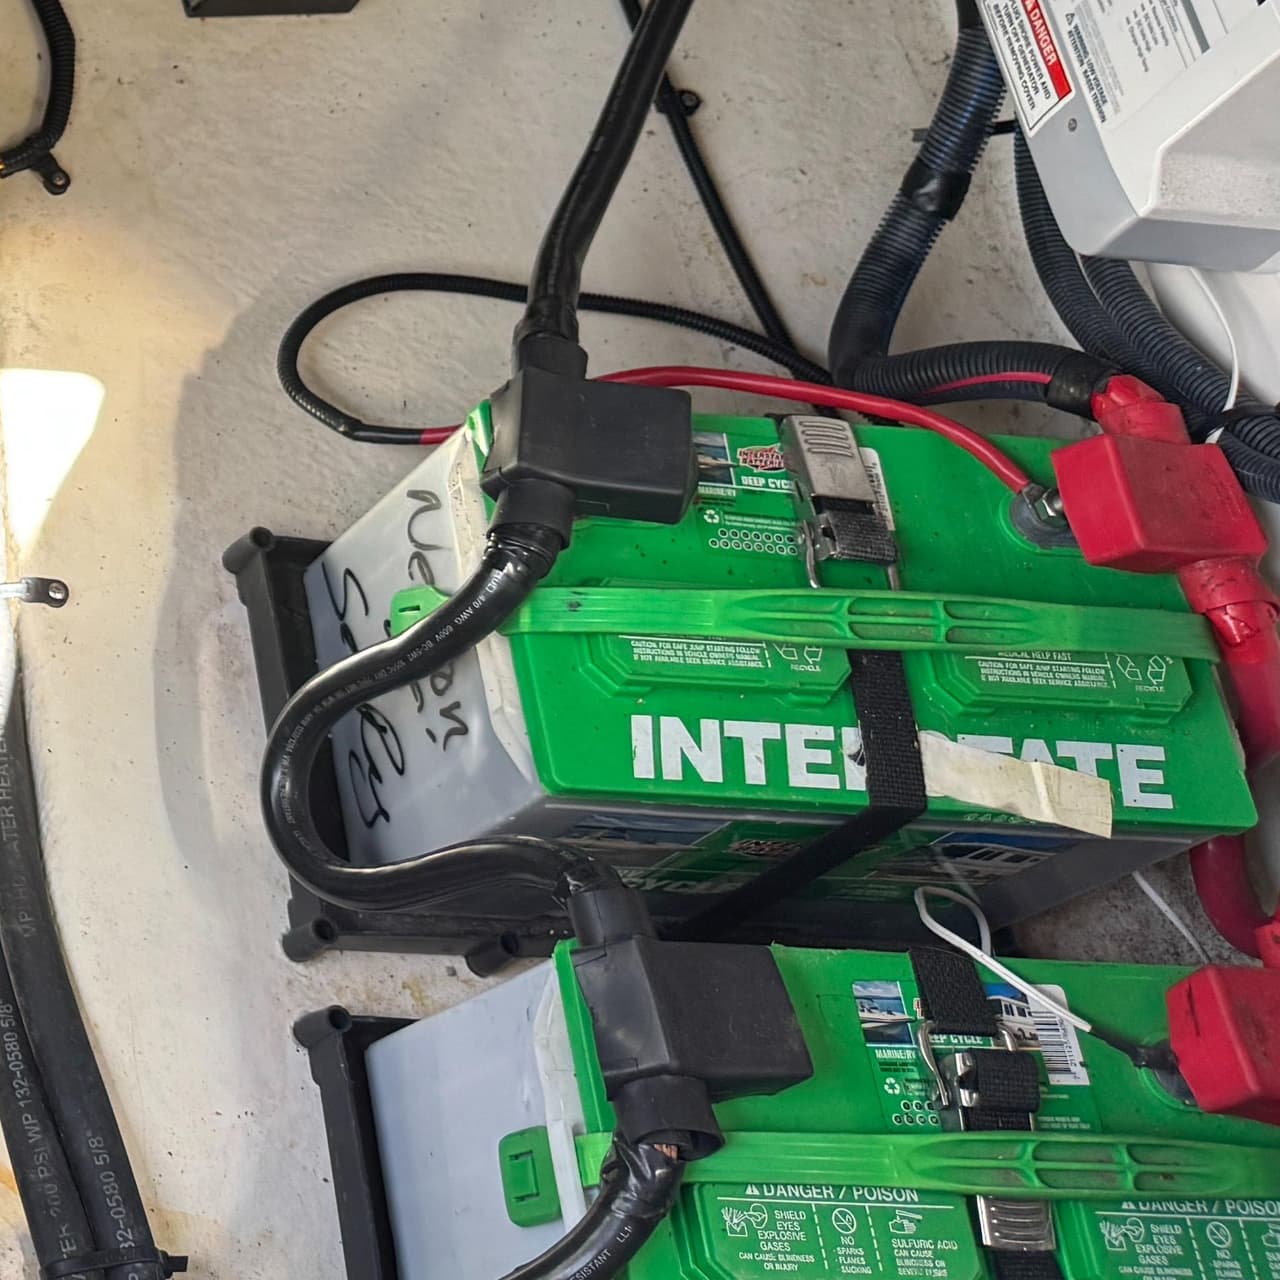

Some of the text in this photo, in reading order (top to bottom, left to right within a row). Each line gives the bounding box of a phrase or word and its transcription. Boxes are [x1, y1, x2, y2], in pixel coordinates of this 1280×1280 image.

[1014, 17, 1035, 49] SHORE
[1026, 7, 1059, 66] DANGER
[999, 2, 1045, 95] TURN OFF GENERATOR
[989, 2, 1039, 111] BEFORE REMOVING COVER
[1024, 47, 1047, 81] POWER
[1037, 78, 1053, 100] AND
[741, 475, 766, 487] DEEP
[450, 604, 476, 626] AWG
[431, 622, 455, 643] 600V
[735, 646, 761, 654] FOLLOW
[1052, 652, 1073, 662] FAST
[1081, 666, 1105, 675] FOLLOW
[951, 1034, 984, 1045] CYCLE
[875, 1049, 916, 1060] MARINE/RV
[1, 1029, 34, 1108] 132-0580
[20, 1110, 43, 1143] WP
[31, 1144, 54, 1179] PSI
[763, 1183, 835, 1200] DANGER
[852, 1187, 919, 1203] POISON
[98, 1167, 137, 1251] 32-0580
[773, 1209, 807, 1220] SHIELD
[776, 1220, 801, 1231] EYES
[1150, 1224, 1182, 1235] SHIELD
[757, 1230, 807, 1241] EXPLOSIVE
[840, 1236, 855, 1246] NO
[1153, 1235, 1177, 1245] EYES
[759, 1241, 791, 1252] GASES
[891, 1238, 959, 1250] SULFURIC ACID
[1135, 1244, 1184, 1255] EXPLOSIVE
[738, 1251, 815, 1263] CAN CAUSE BLINDNESS
[893, 1249, 934, 1259] CAN CAUSE
[1216, 1250, 1232, 1260] NO
[896, 1258, 946, 1268] BLINDNESS OR
[1138, 1255, 1169, 1265] GASES
[763, 1262, 799, 1272] OR INJURY
